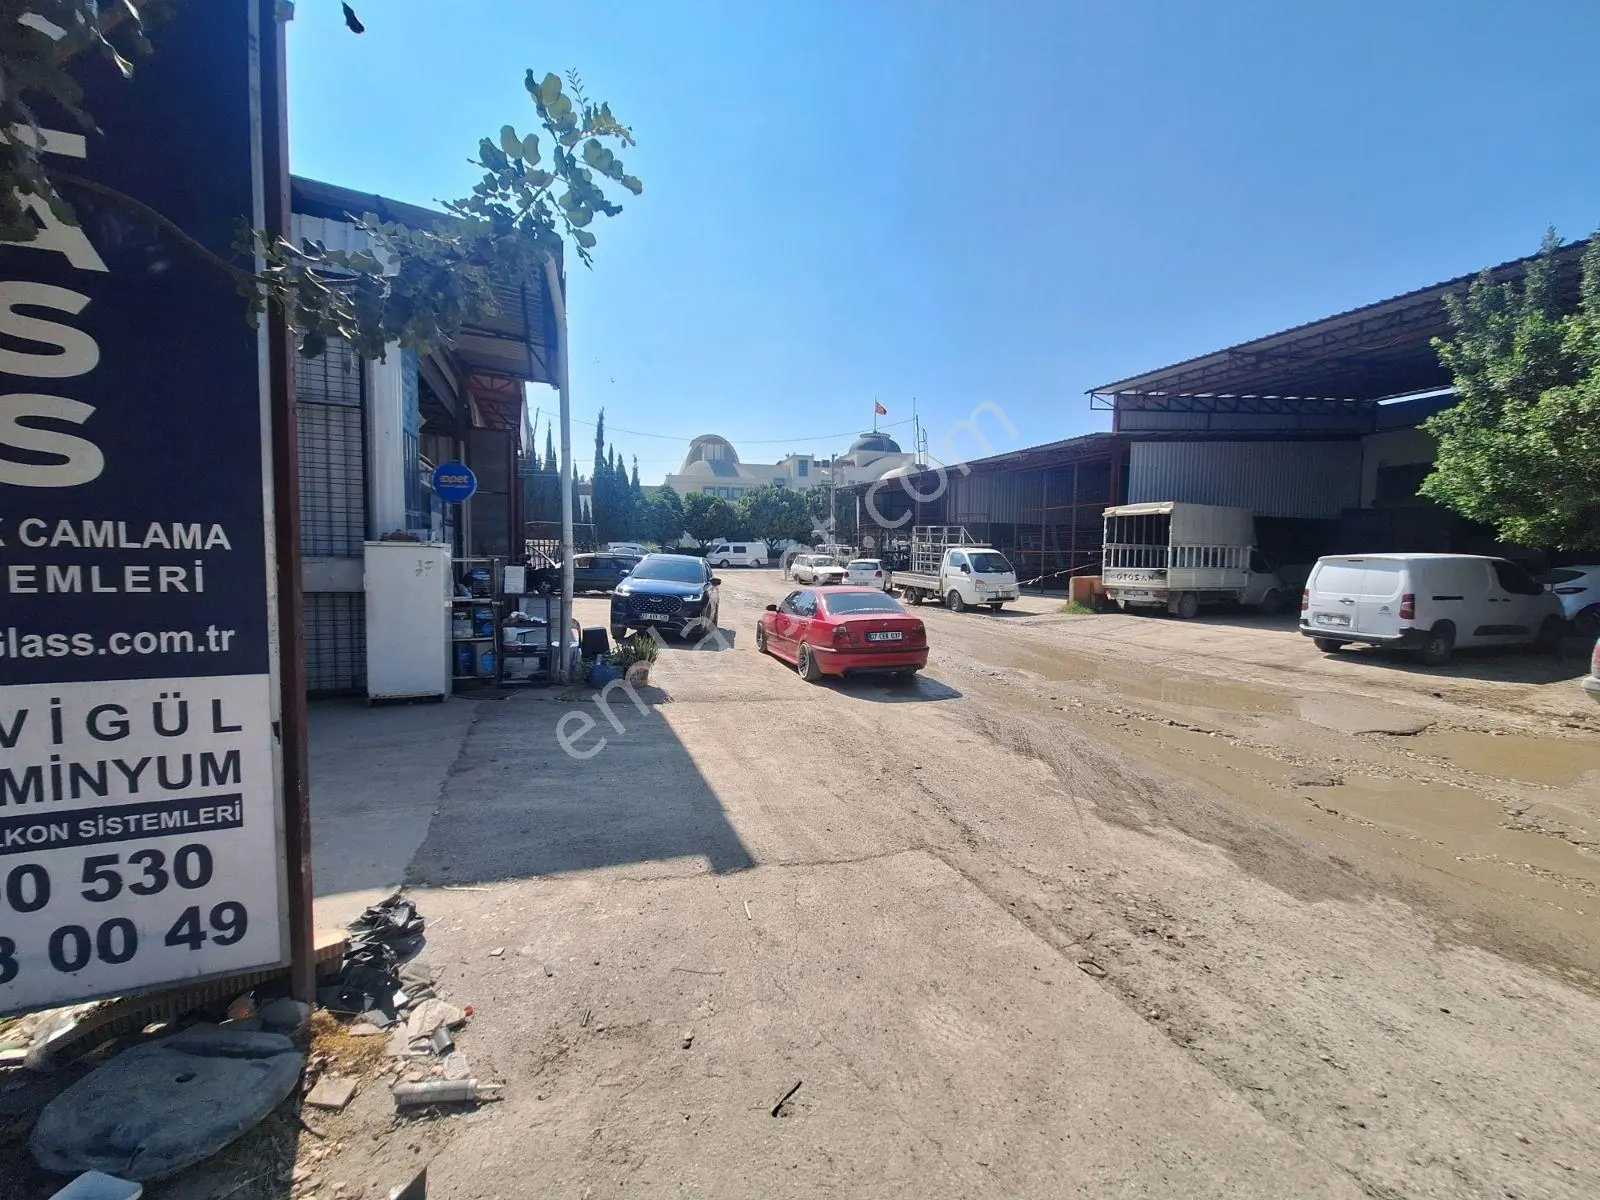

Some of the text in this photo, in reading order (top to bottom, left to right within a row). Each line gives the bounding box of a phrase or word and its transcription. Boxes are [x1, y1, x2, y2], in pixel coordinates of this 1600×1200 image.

[18, 517, 232, 551] CAMLAMA
[8, 559, 204, 594] EMLERİ
[0, 624, 236, 659] lass.com.tr
[0, 749, 241, 806] MİNYUM
[0, 801, 241, 849] KON SİSTEMLERİ
[81, 843, 213, 902] 530
[48, 917, 138, 972] 00
[164, 901, 248, 951] 49
